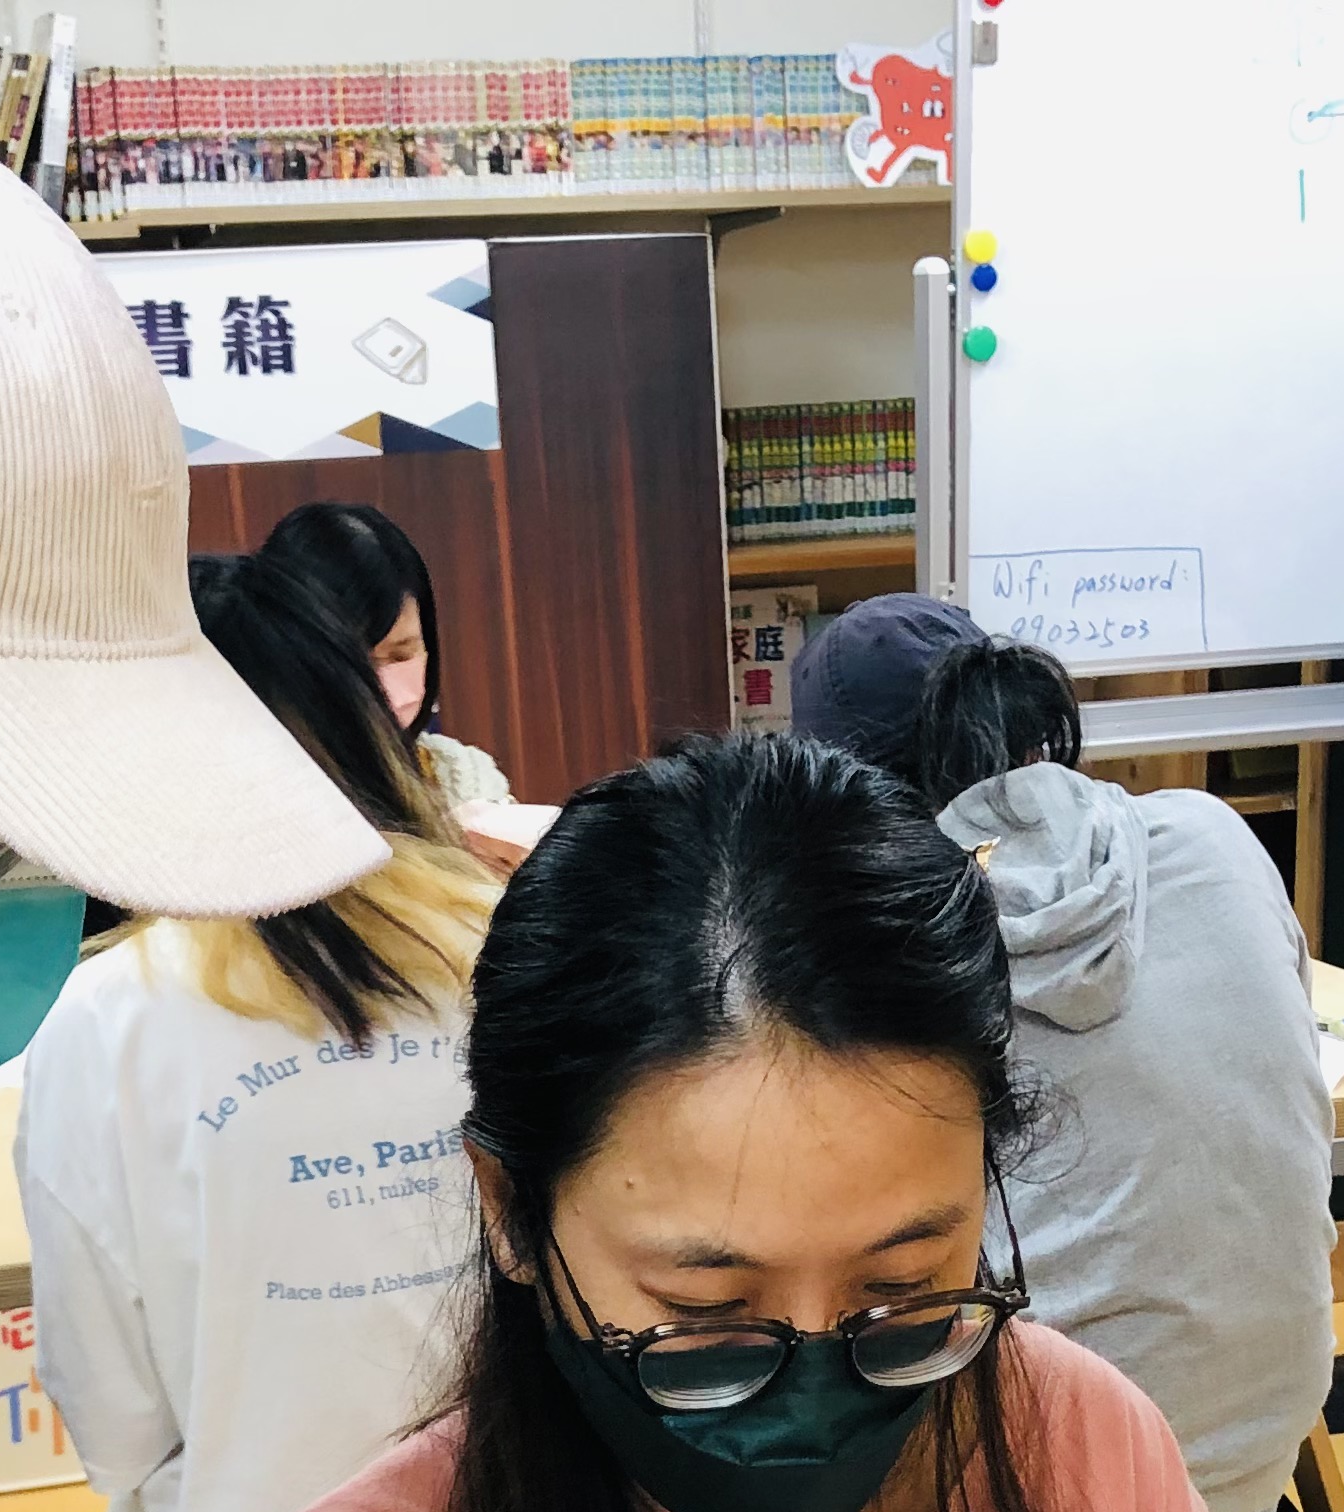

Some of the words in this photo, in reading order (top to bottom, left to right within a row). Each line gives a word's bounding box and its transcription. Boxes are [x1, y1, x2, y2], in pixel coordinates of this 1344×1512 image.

[126, 295, 295, 377] 書籍
[197, 1095, 239, 1132] Le
[236, 1054, 302, 1097] Mur
[316, 1039, 375, 1065] des
[387, 1033, 421, 1064] Je
[289, 1154, 366, 1184] Ave,
[372, 1127, 464, 1169] Paris
[265, 1281, 323, 1301] Place
[328, 1280, 367, 1299] des
